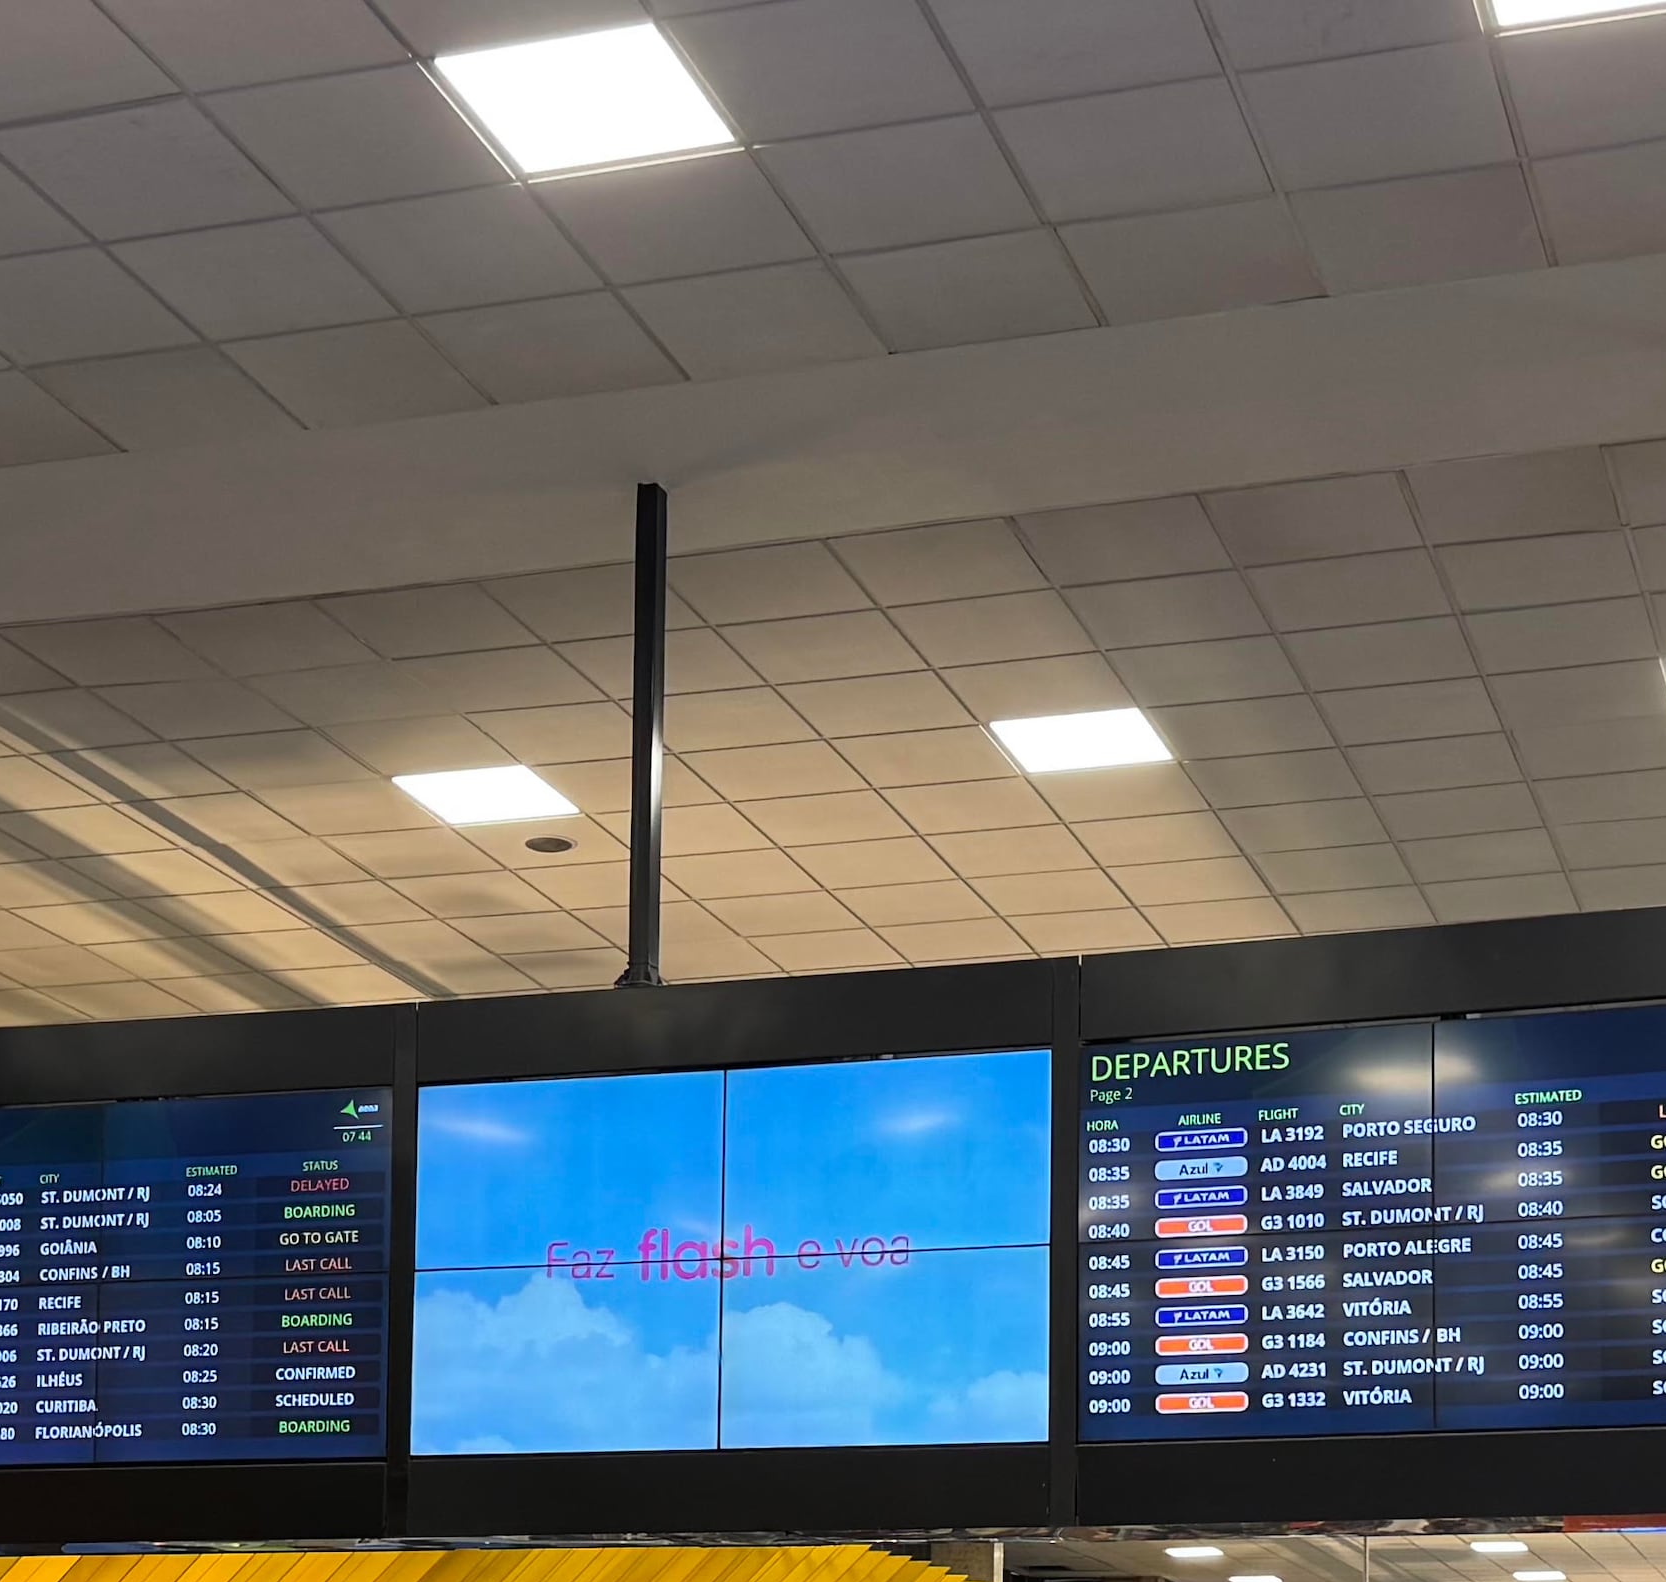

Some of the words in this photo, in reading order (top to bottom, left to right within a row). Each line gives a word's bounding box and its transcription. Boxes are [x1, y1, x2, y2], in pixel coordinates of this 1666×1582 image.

[1091, 1042, 1290, 1082] DEPARTURES
[1090, 1088, 1122, 1105] Page
[1124, 1086, 1133, 1100] 2
[1514, 1089, 1583, 1105] ESTIMATED
[1258, 1107, 1299, 1122] FLIGHT
[1339, 1103, 1365, 1116] CITY
[1086, 1119, 1119, 1132] HORA
[1177, 1112, 1222, 1126] AIRLINE
[1342, 1120, 1401, 1139] PORTO
[1403, 1116, 1477, 1135] SEGURO
[1517, 1110, 1563, 1128] 08:30
[1261, 1127, 1283, 1144] LA
[1284, 1125, 1325, 1143] 3192
[1088, 1137, 1131, 1154] 08:30
[1517, 1140, 1563, 1158] 08:35
[1260, 1156, 1286, 1173] AD
[1287, 1154, 1327, 1171] 4004
[1342, 1149, 1398, 1168] RECIFE
[1088, 1165, 1131, 1182] 08:35
[1517, 1170, 1563, 1188] 08:35
[290, 1177, 350, 1192] DELAYED
[1261, 1185, 1283, 1202] LA
[1284, 1183, 1325, 1201] 3849
[1341, 1177, 1433, 1197] SALVADOR
[284, 1203, 356, 1220] BOARDING
[1088, 1194, 1131, 1211] 08:35
[1517, 1200, 1564, 1218] 08:40
[1260, 1214, 1284, 1231] G3
[1286, 1212, 1325, 1230] 1010
[1341, 1210, 1367, 1227] ST.
[1370, 1205, 1453, 1225] DUMONT
[1466, 1204, 1484, 1224] RJ
[279, 1232, 300, 1246] GO
[301, 1231, 322, 1245] TO
[324, 1229, 359, 1244] GATE
[1088, 1223, 1131, 1240] 08:40
[39, 1238, 98, 1256] GOIÂNIA
[1343, 1240, 1402, 1259] PORTO
[1403, 1237, 1472, 1256] ALEGRE
[1517, 1232, 1564, 1250] 08:45
[547, 1241, 616, 1279] Faz
[639, 1225, 775, 1281] flash
[798, 1236, 821, 1269] e
[835, 1234, 910, 1268] voa
[1261, 1246, 1284, 1263] LA
[1285, 1244, 1325, 1261] 3150
[1088, 1254, 1131, 1271] 08:45
[1517, 1262, 1564, 1280] 08:45
[1261, 1276, 1284, 1292] G3
[1286, 1273, 1326, 1291] 1566
[1342, 1269, 1434, 1288] SALVADOR
[1088, 1283, 1131, 1300] 08:45
[38, 1295, 82, 1310] RECIFE
[1342, 1296, 1412, 1318] VITÓRIA
[1518, 1292, 1564, 1310] 08:55
[281, 1312, 353, 1328] BOARDING
[1088, 1311, 1131, 1328] 08:55
[1261, 1305, 1284, 1321] LA
[1285, 1303, 1326, 1320] 3642
[37, 1318, 102, 1336] RIBEIRÃO
[103, 1318, 146, 1334] PRETO
[1518, 1322, 1564, 1340] 09:00
[1261, 1334, 1285, 1350] G3
[1287, 1332, 1326, 1349] 1184
[1343, 1327, 1420, 1347] CONFINS
[1436, 1326, 1461, 1343] BH
[1088, 1340, 1131, 1357] 09:00
[1261, 1363, 1287, 1379] AD
[1288, 1361, 1327, 1379] 4231
[1343, 1360, 1368, 1377] ST.
[1371, 1357, 1454, 1376] DUMONT
[1467, 1355, 1485, 1376] RJ
[1518, 1353, 1565, 1370] 09:00
[36, 1370, 83, 1388] ILHÉUS
[275, 1365, 356, 1381] CONFIRMED
[1088, 1369, 1131, 1385] 09:00
[275, 1392, 355, 1408] SCHEDULED
[1261, 1392, 1285, 1409] G3
[1287, 1391, 1327, 1408] 1332
[1342, 1385, 1413, 1406] VITÓRIA
[1518, 1383, 1565, 1400] 09:00
[35, 1399, 96, 1414] CURITIBA
[1088, 1398, 1131, 1414] 09:00
[35, 1421, 143, 1440] FLORIANÓPOLIS
[278, 1419, 350, 1434] BOARDING
